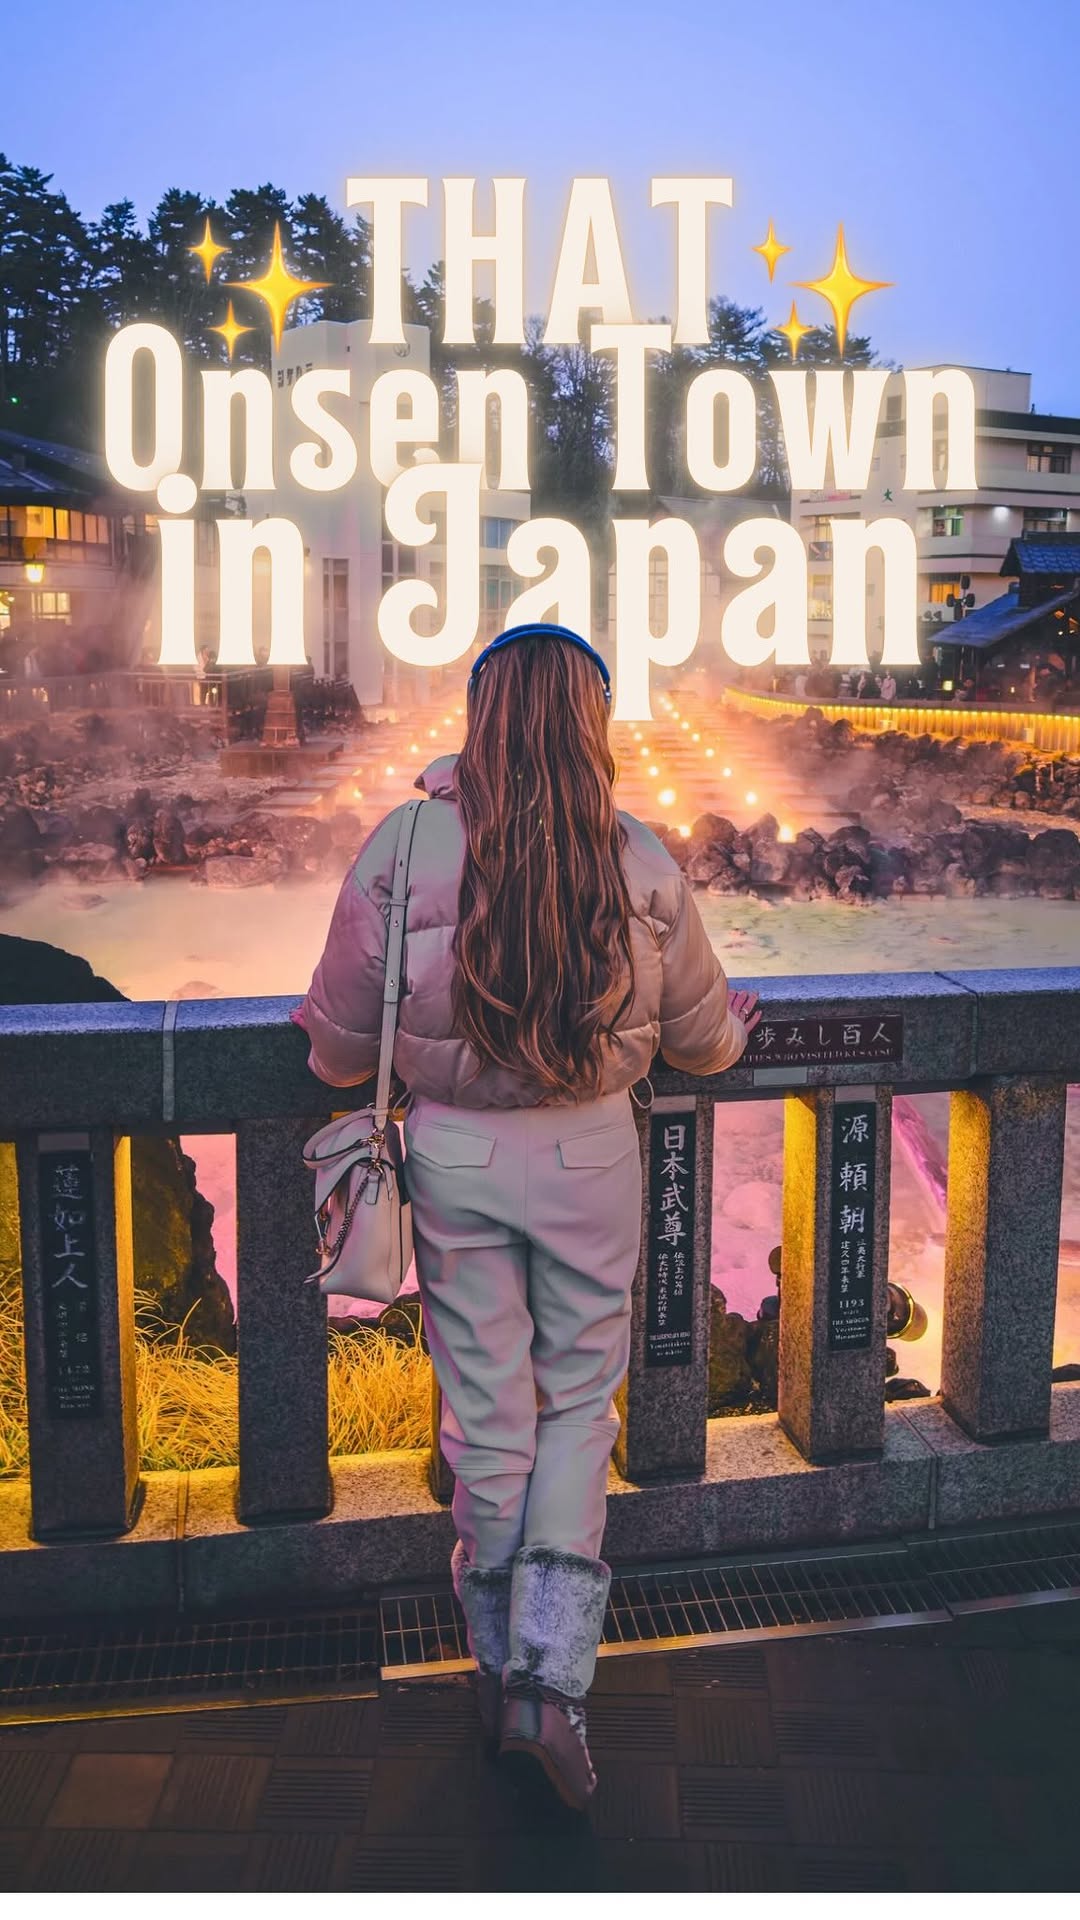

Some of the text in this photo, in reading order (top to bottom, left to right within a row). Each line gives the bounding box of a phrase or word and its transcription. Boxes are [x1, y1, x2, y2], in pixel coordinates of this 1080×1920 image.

[52, 1163, 88, 1289] 蓮如上人
[657, 1124, 689, 1247] 日本武尊
[839, 1114, 869, 1234] 源頼朝
[839, 1298, 865, 1309] 1193
